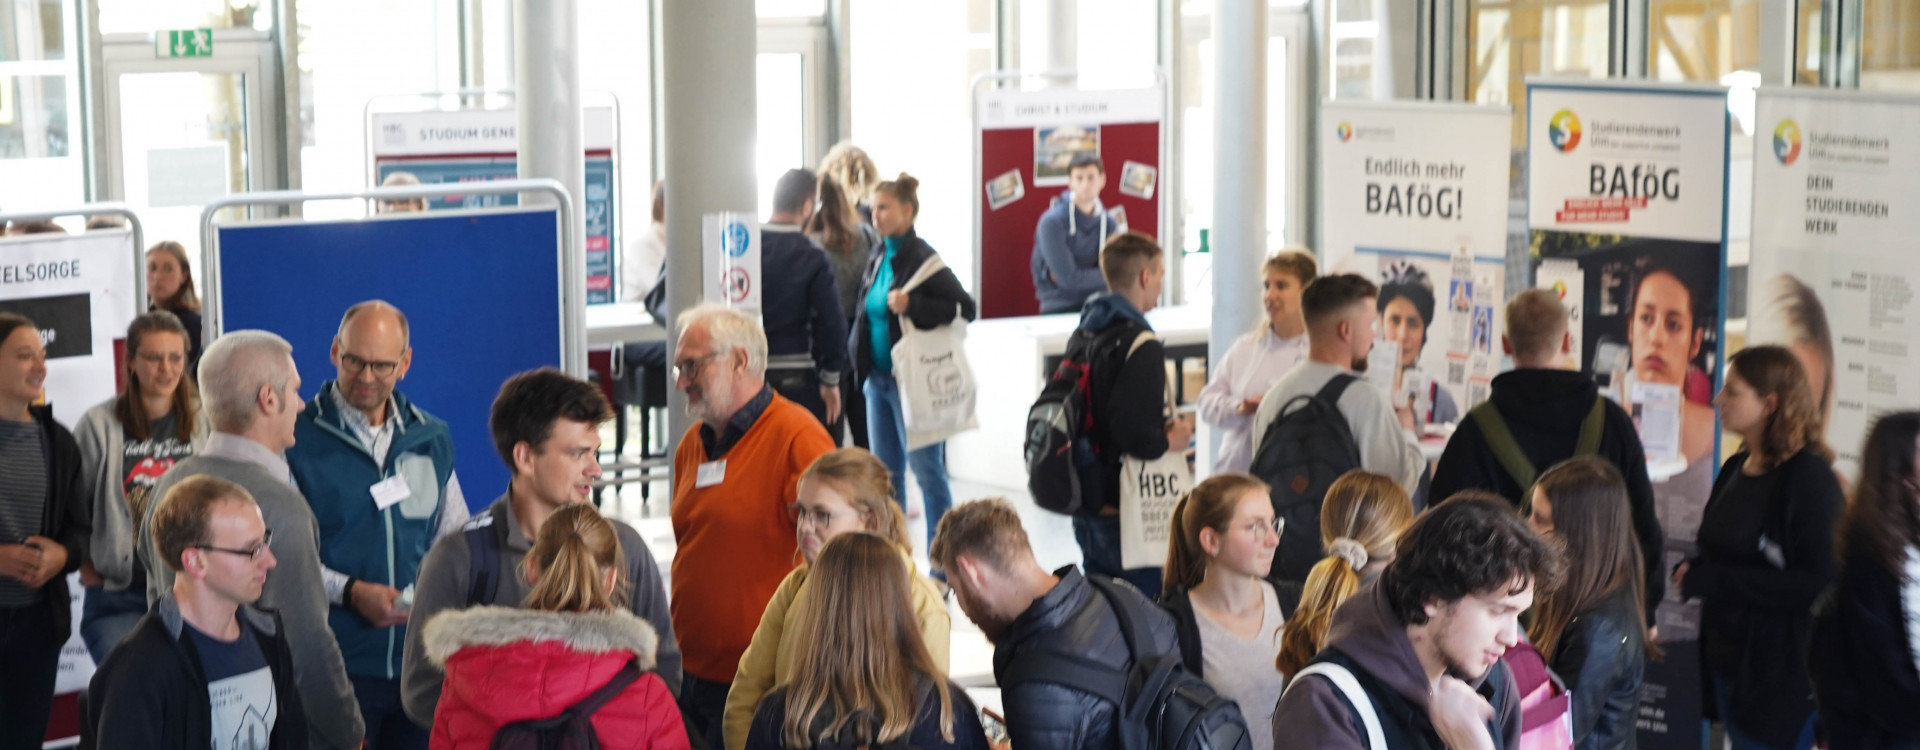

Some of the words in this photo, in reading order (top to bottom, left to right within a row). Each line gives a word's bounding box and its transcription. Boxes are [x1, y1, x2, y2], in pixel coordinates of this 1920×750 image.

[419, 127, 478, 141] STUDIUM
[481, 126, 516, 139] GENE
[1591, 120, 1681, 137] Studierendenwerk
[1808, 131, 1889, 150] Studierendenwerk
[1365, 157, 1421, 177] Endlich
[1425, 159, 1465, 179] mehr
[1590, 164, 1680, 202] BAföG
[1807, 175, 1833, 190] DEIN
[1366, 182, 1463, 220] BAföG!
[1806, 197, 1889, 218] STUDIERENDEN
[1805, 219, 1838, 234] WERK
[0, 259, 80, 284] ELSORGE
